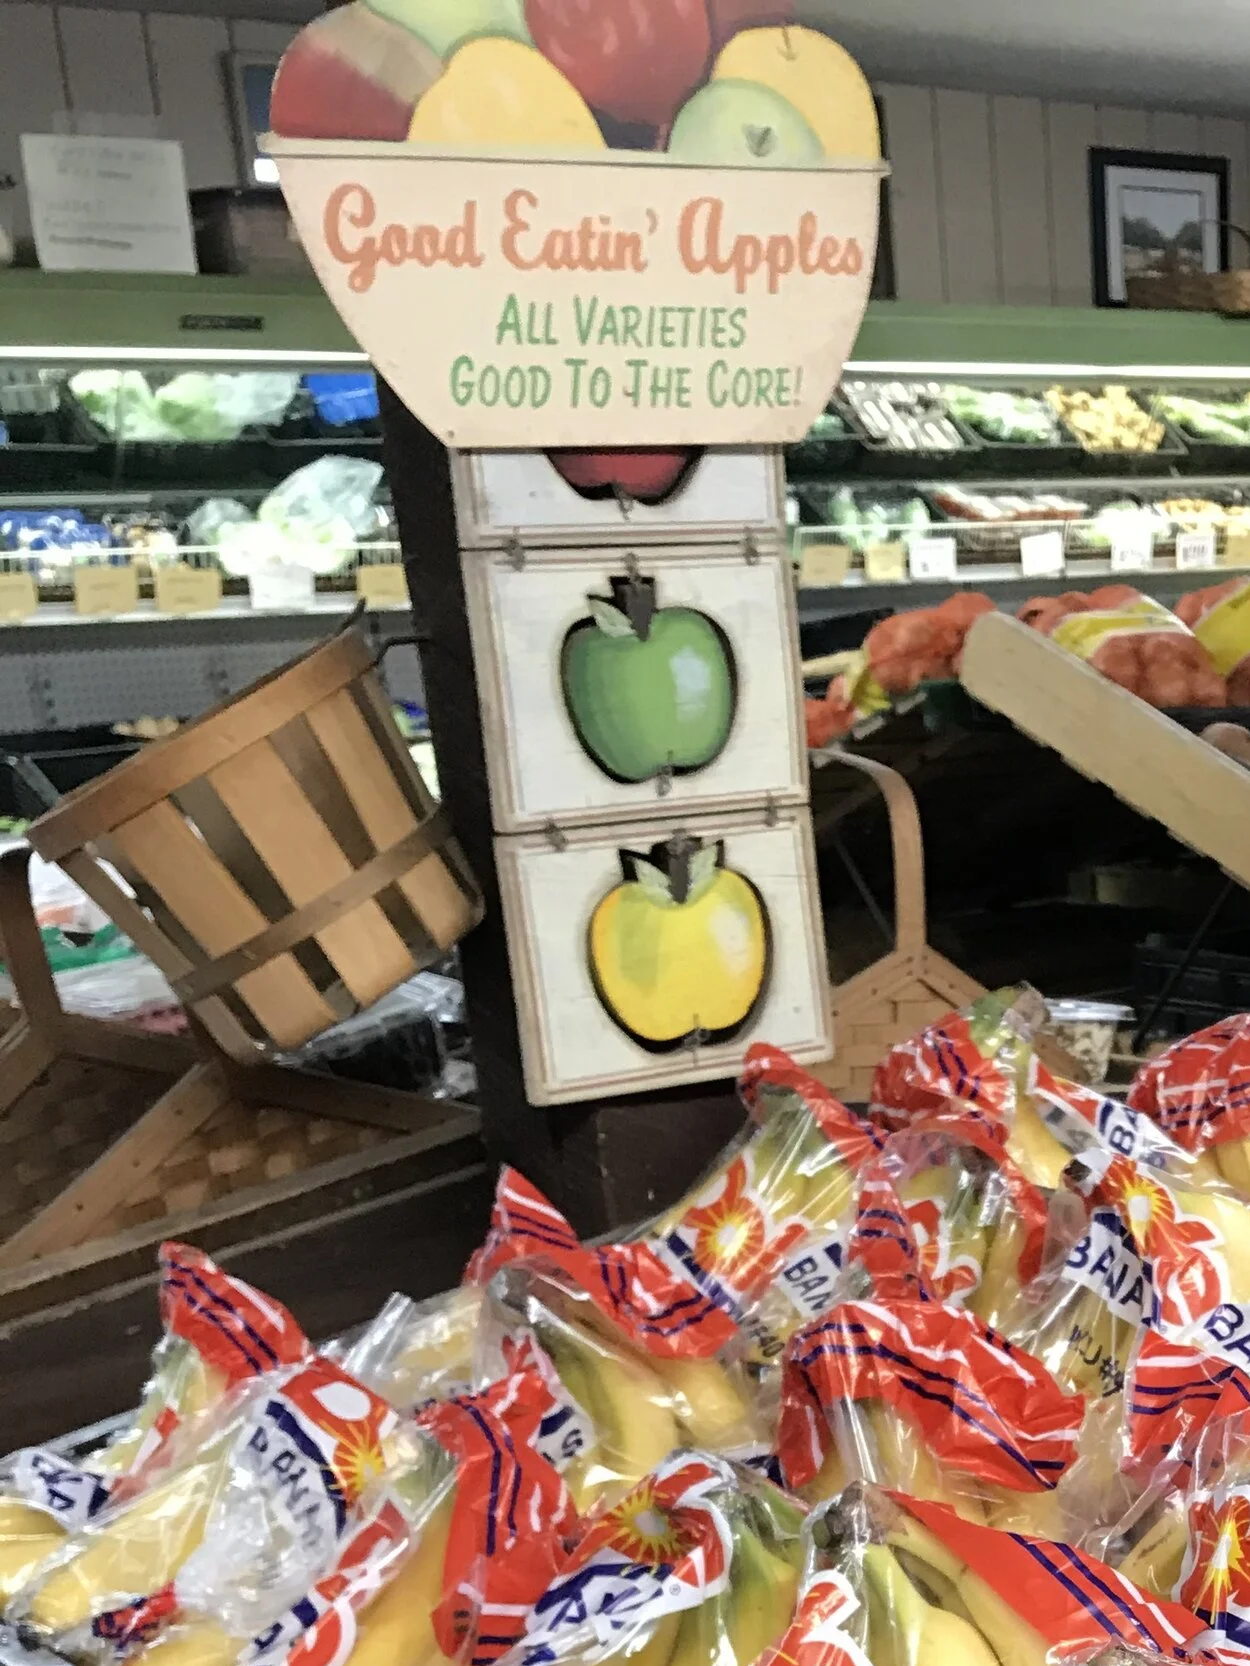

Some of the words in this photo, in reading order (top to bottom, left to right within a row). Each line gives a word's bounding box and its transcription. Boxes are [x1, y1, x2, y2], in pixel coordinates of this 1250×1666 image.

[323, 182, 486, 293] Good
[500, 188, 658, 274] Eatin'
[678, 196, 863, 294] Apples
[496, 293, 557, 346] ALL
[573, 295, 748, 349] VARIETIES
[450, 355, 551, 409] GOOD
[564, 358, 612, 409] TO
[625, 359, 692, 409] THE
[706, 360, 803, 409] CORE!
